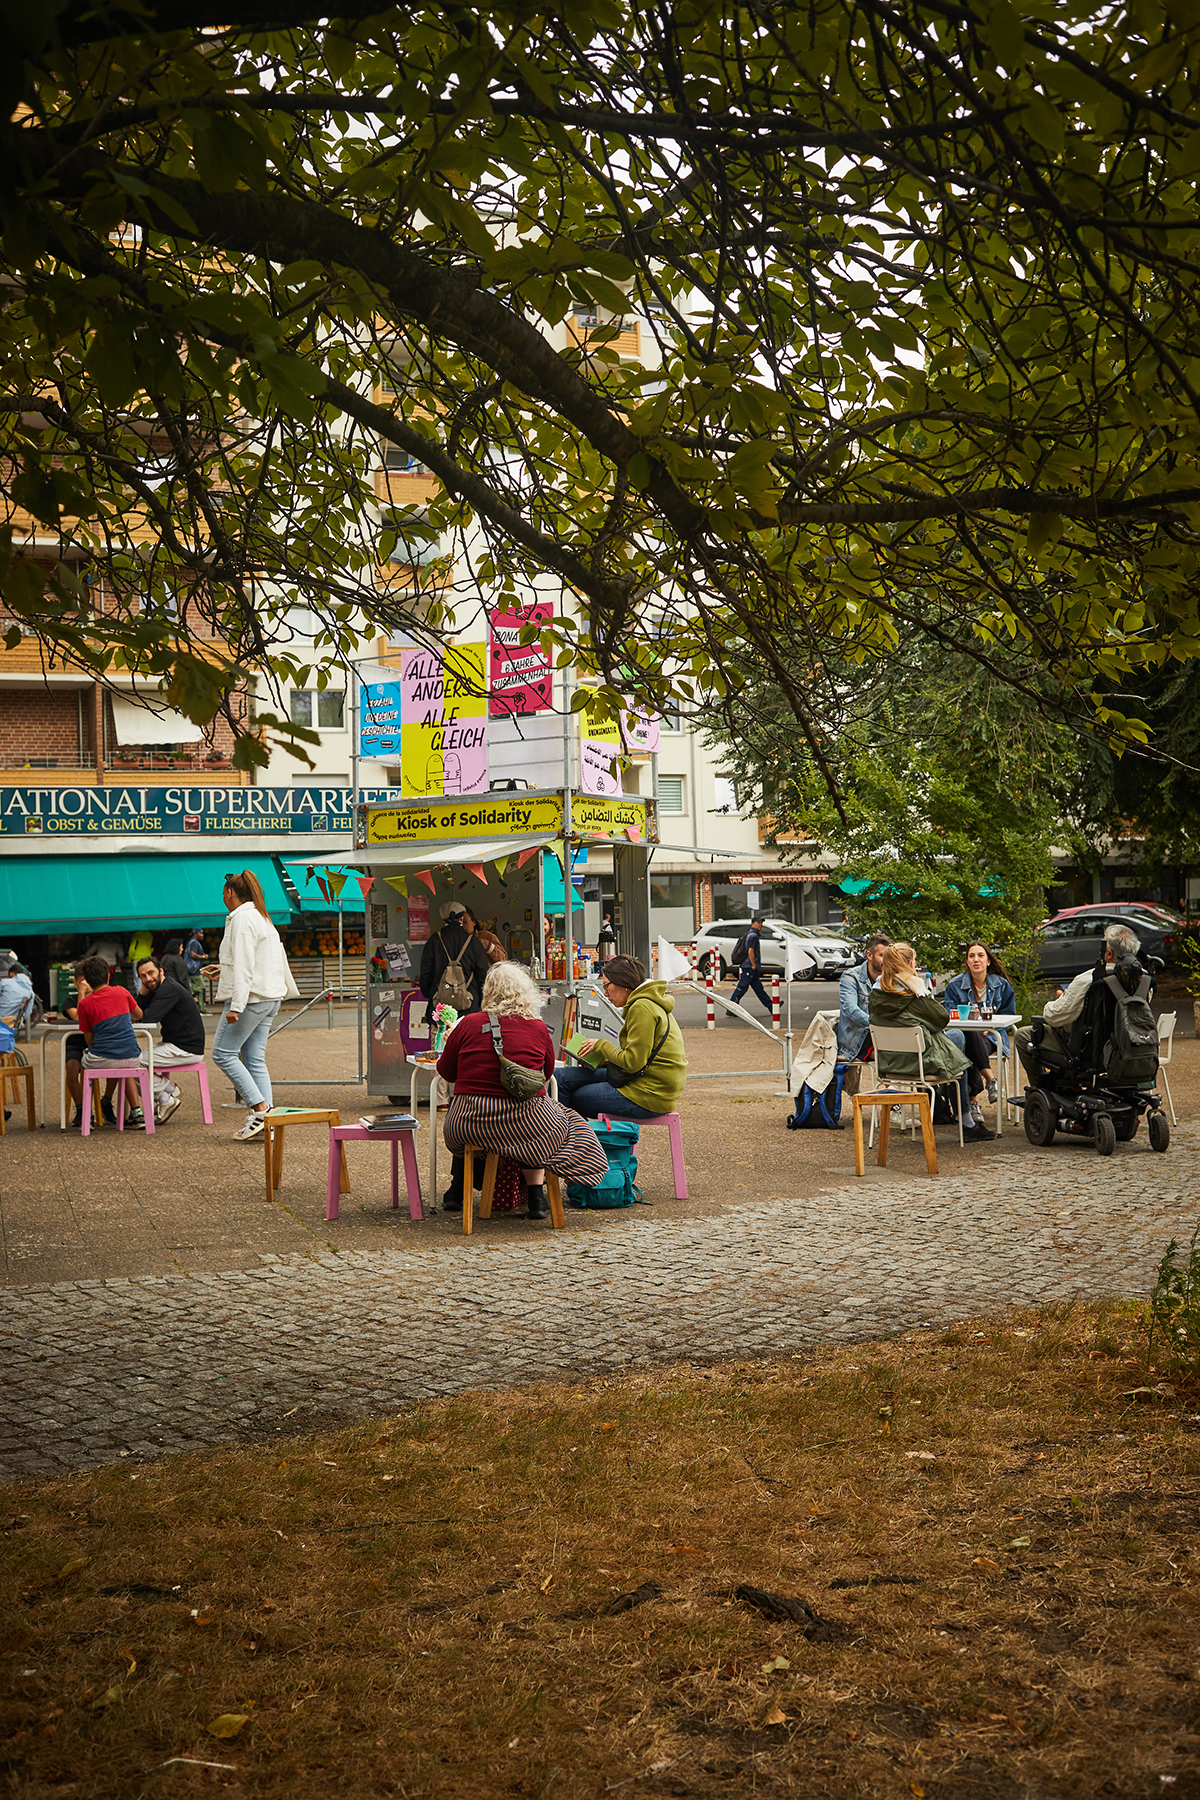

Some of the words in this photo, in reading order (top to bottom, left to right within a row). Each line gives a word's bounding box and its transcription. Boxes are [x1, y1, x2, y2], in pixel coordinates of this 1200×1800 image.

[408, 658, 447, 681] ALLE
[505, 664, 510, 673] 6
[421, 707, 460, 729] ALLE
[431, 727, 486, 751] GLEICH
[0, 789, 158, 815] ATIONAL
[47, 818, 84, 831] OBST
[87, 818, 99, 831] &
[101, 815, 162, 831] GEMÜSE
[205, 817, 292, 829] FLEISCHEREI
[397, 814, 437, 830] Kiosk
[440, 812, 457, 827] of
[459, 807, 532, 826] Solidarity
